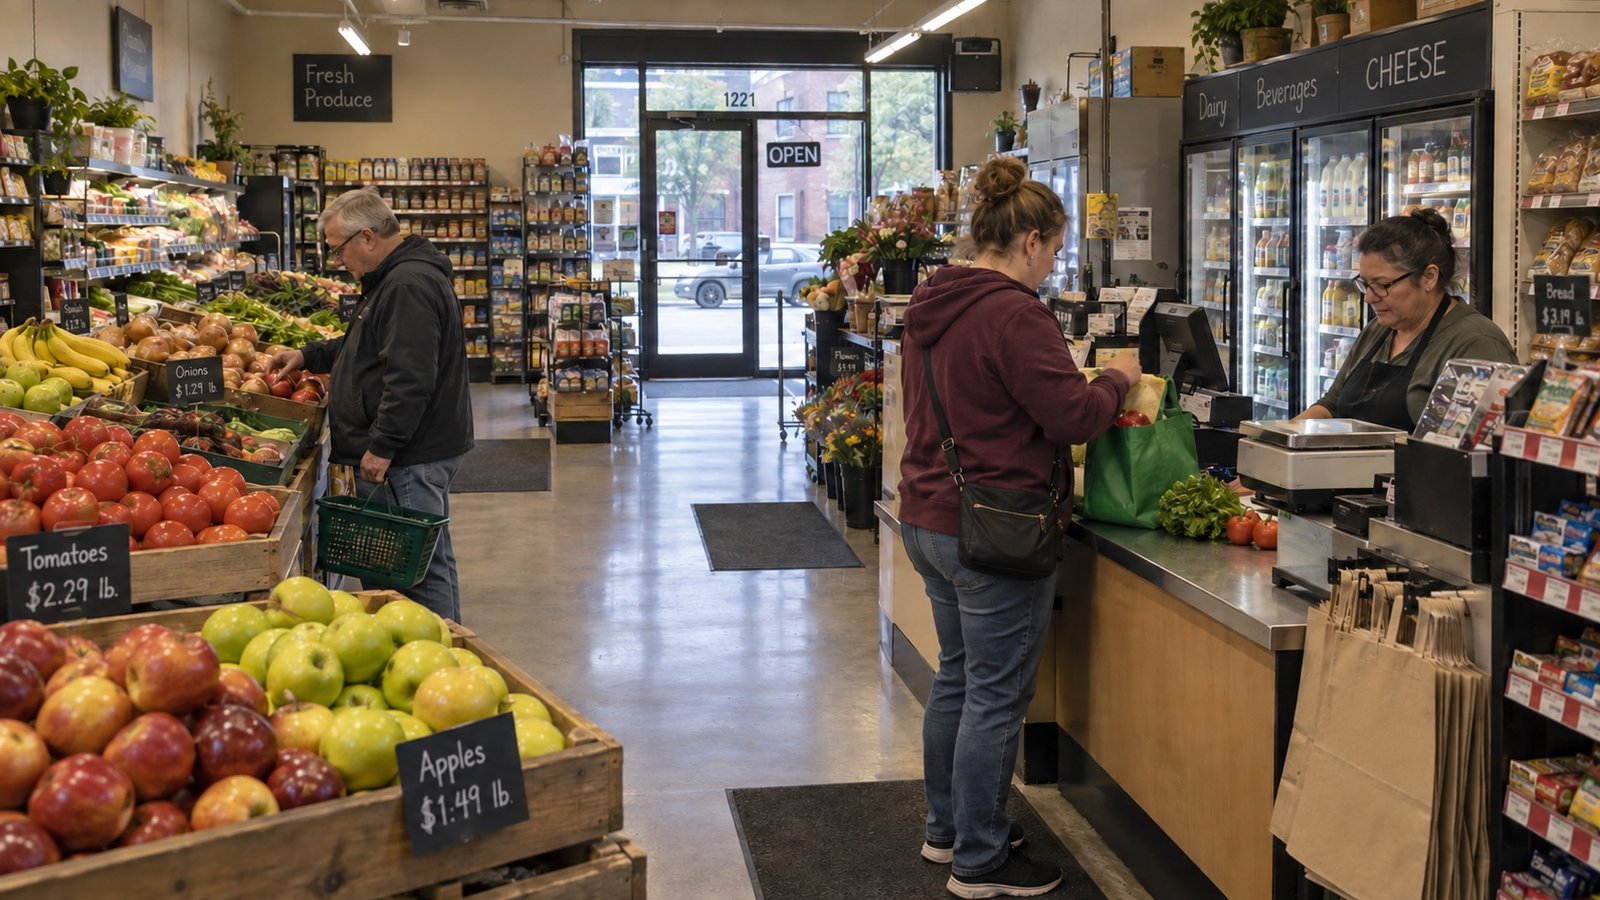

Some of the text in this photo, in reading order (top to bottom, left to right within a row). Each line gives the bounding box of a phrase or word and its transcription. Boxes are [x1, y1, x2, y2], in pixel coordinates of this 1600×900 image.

[306, 63, 354, 84] Fresh
[1366, 40, 1447, 90] CHEESE
[304, 88, 373, 108] Produce
[723, 92, 755, 107] 1221
[1257, 77, 1318, 113] Beverages
[1199, 92, 1227, 128] Dairy
[769, 146, 818, 164] OPEN
[1546, 282, 1575, 300] Bread
[1541, 306, 1570, 326] $3.19
[175, 365, 208, 379] Onions
[175, 382, 203, 399] $1.29
[19, 543, 108, 571] Tomatoes
[25, 576, 119, 613] $2.29 lb.
[420, 740, 486, 788] Apples
[492, 778, 514, 808] lb.
